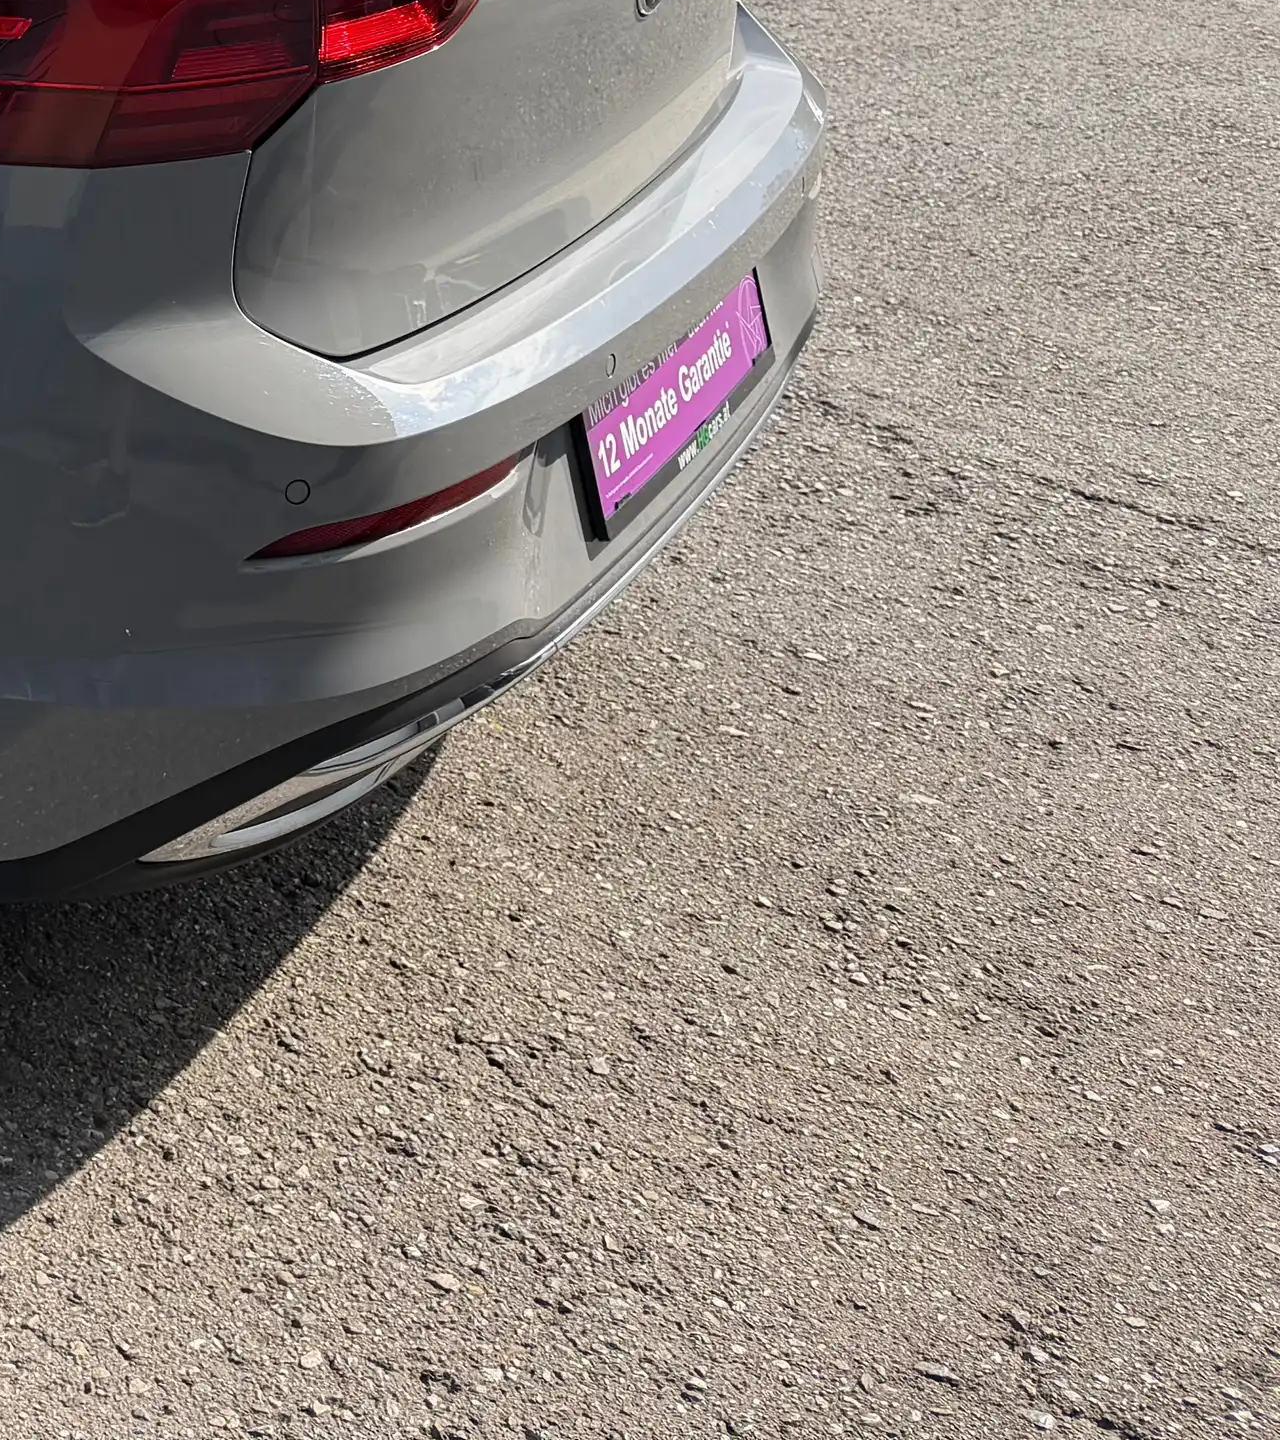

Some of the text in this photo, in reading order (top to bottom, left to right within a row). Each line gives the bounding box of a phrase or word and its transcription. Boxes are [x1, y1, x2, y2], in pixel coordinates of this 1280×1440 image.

[597, 433, 621, 478] 12
[619, 388, 678, 460] Monate
[677, 401, 731, 470] www.HGcars.at
